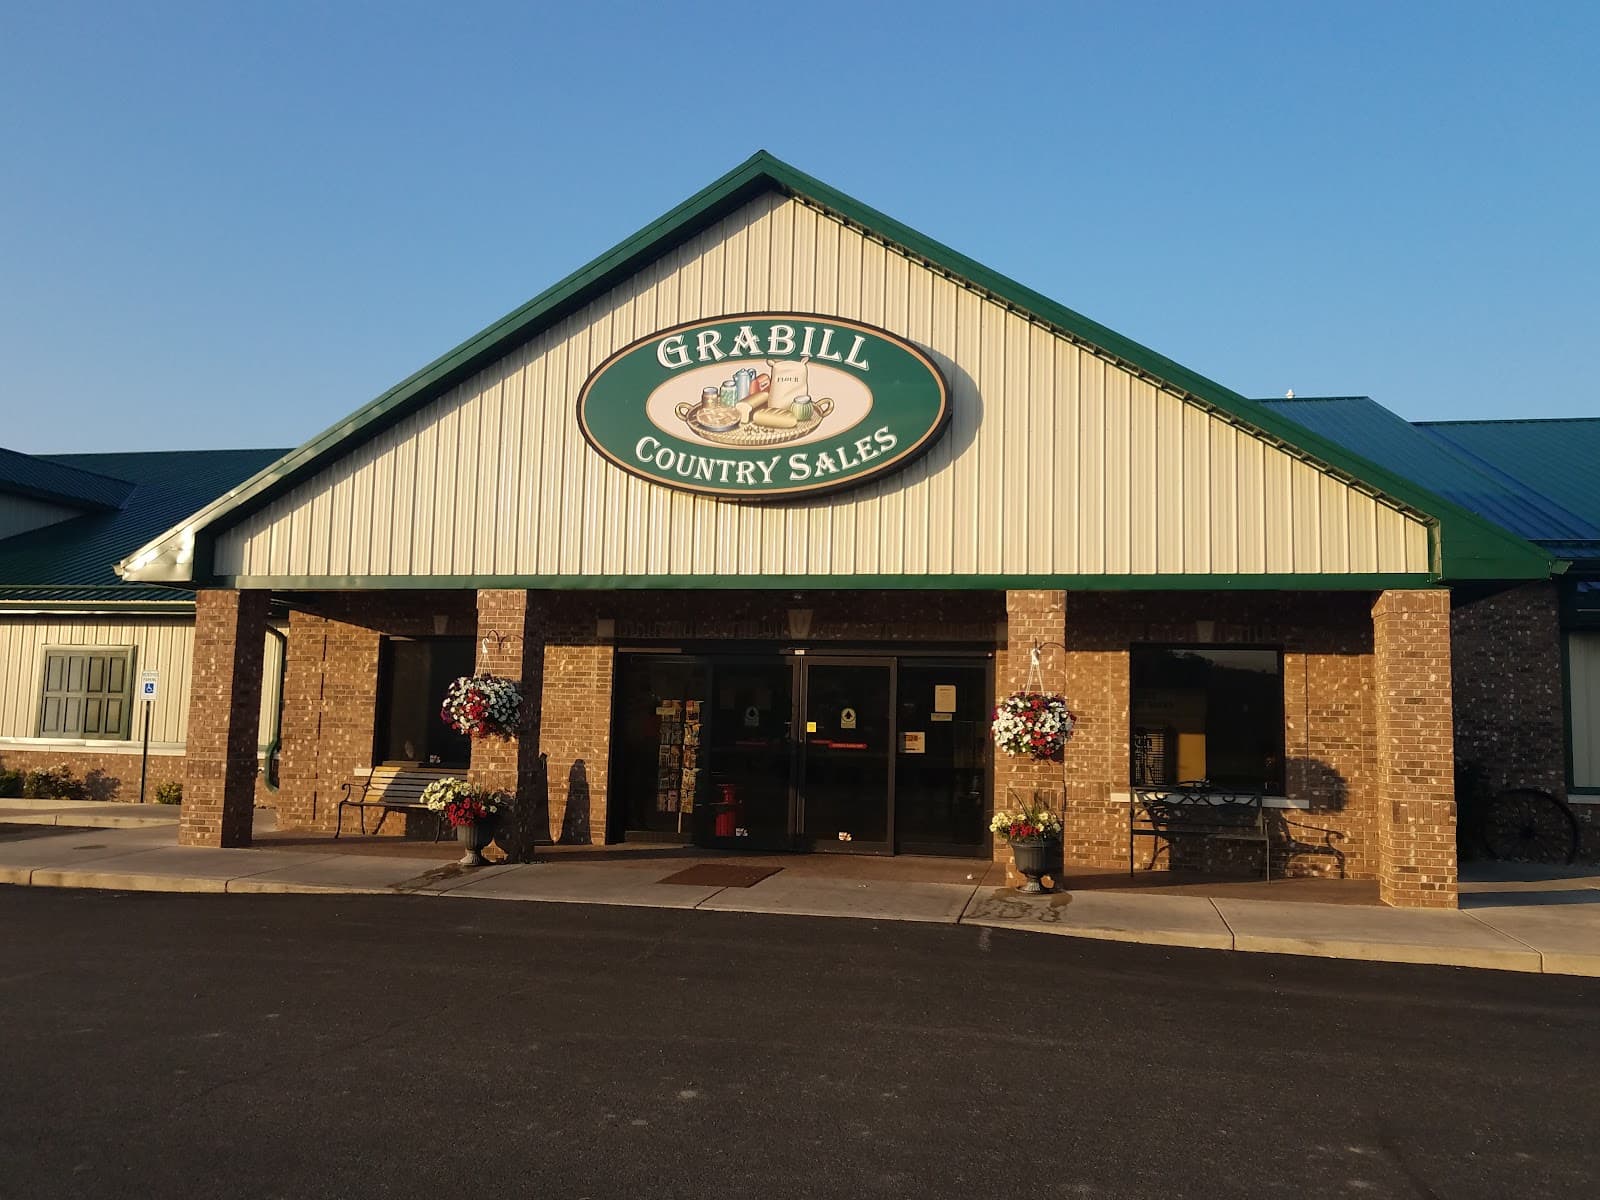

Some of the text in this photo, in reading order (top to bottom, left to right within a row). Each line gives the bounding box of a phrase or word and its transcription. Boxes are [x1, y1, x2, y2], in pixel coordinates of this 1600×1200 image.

[657, 325, 869, 370] GRABILL
[635, 426, 898, 485] COUNTRY SALES
